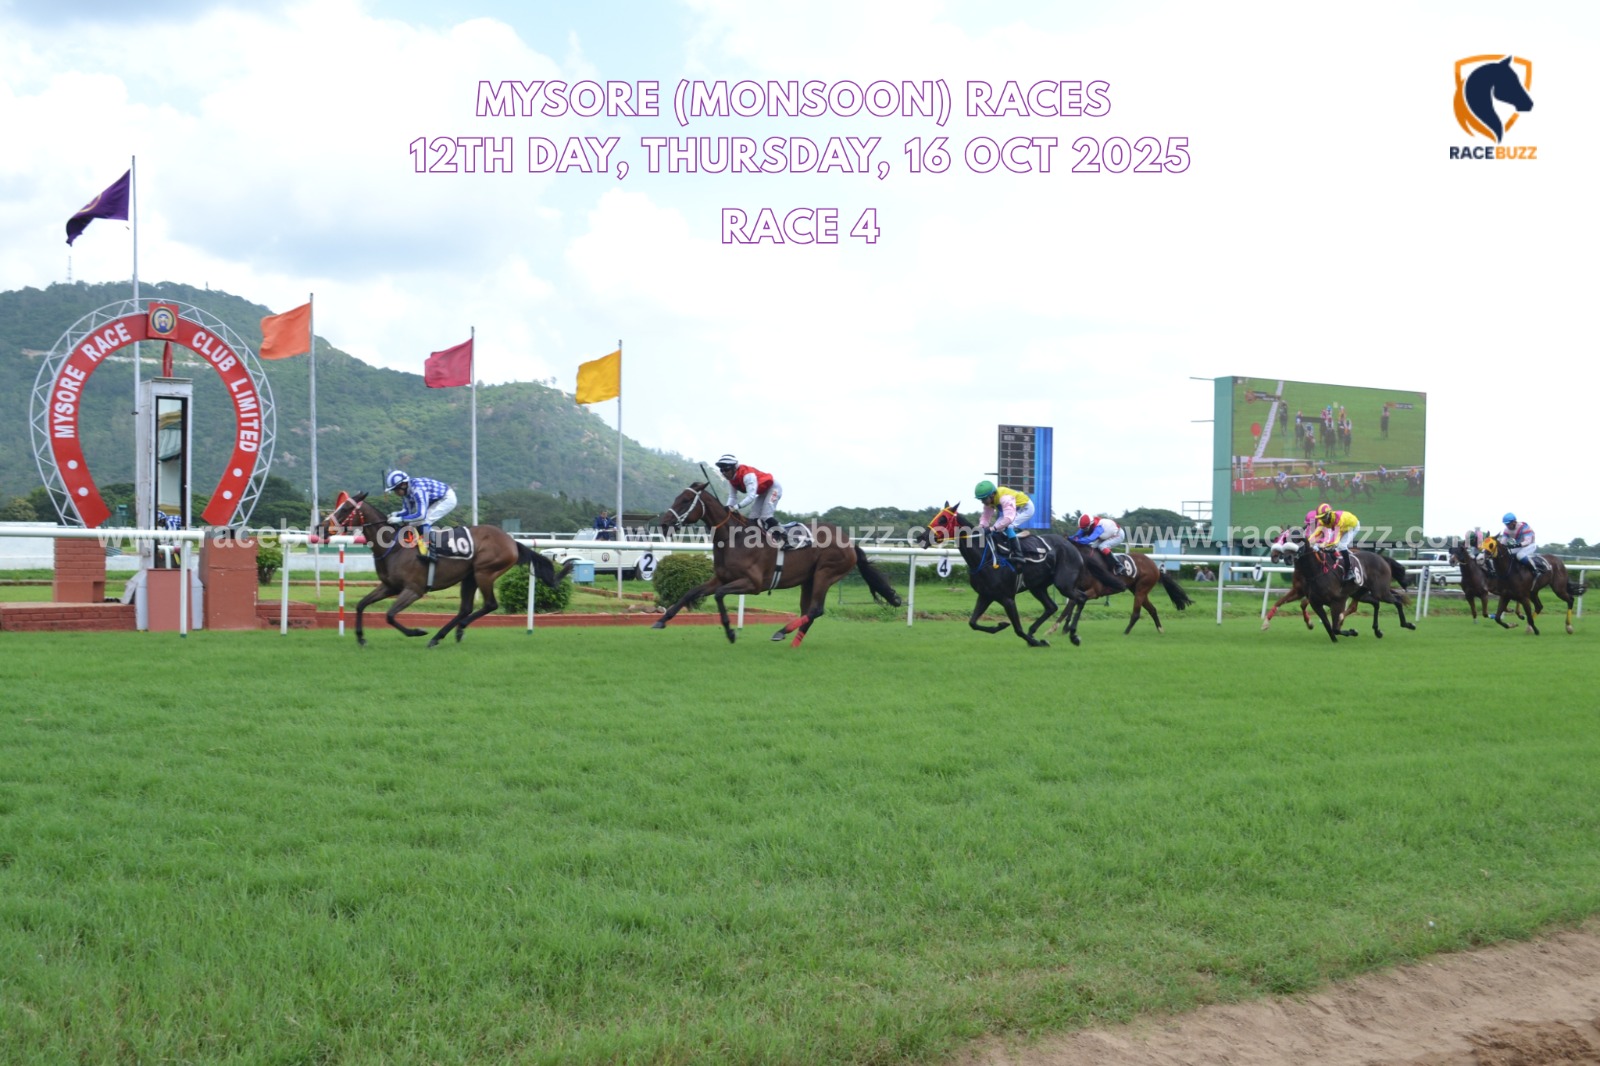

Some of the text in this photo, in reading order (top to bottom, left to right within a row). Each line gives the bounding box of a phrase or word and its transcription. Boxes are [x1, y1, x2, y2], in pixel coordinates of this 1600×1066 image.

[54, 322, 260, 453] MYSORE RACE CLUB LIMITED
[447, 537, 470, 555] 10
[643, 553, 654, 571] 2
[939, 558, 948, 575] 4
[1124, 560, 1133, 576] 9
[1255, 566, 1261, 580] 7
[1353, 566, 1362, 583] 6
